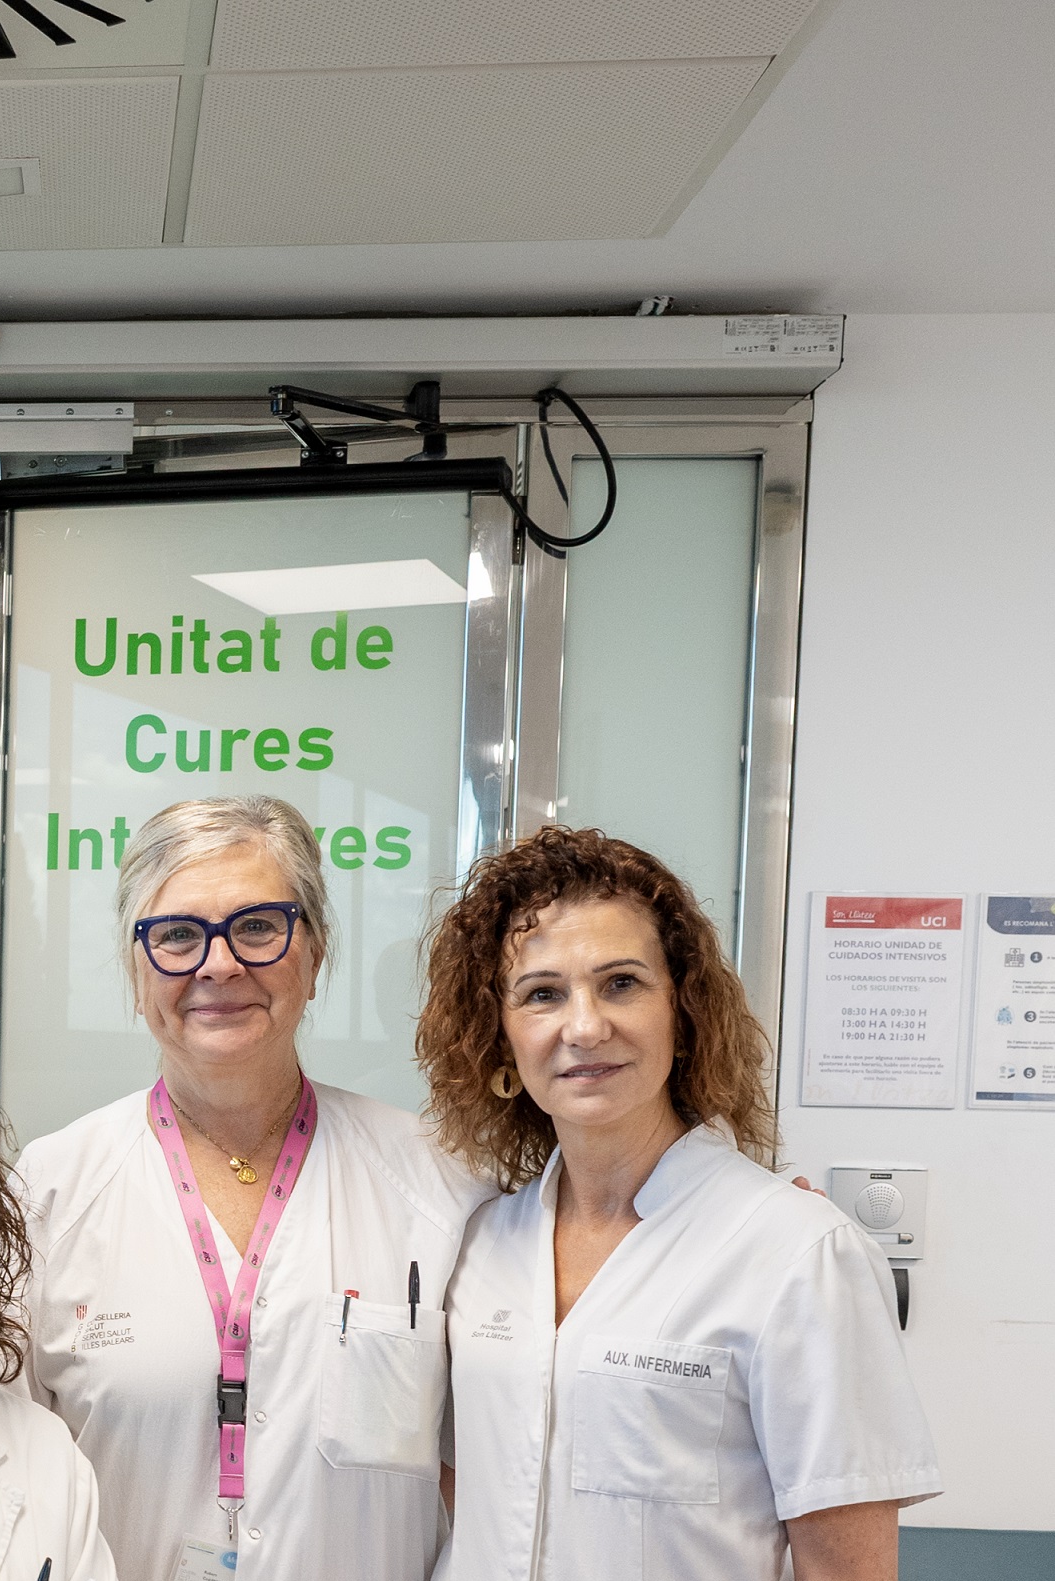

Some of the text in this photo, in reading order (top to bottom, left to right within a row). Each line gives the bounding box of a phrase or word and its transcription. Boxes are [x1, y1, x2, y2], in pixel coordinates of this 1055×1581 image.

[74, 611, 394, 677] Unitat de
[125, 714, 334, 773] Cures
[920, 916, 947, 927] UCI
[834, 941, 943, 950] HORARIO UNIDAD DE
[828, 952, 947, 961] CUIDADOS INTENSIVOS
[843, 975, 887, 983] HORARIOS
[841, 1008, 927, 1017] 08:30 H A 09:30 H
[841, 1020, 926, 1029] 13:00 H A 14:30 H
[841, 1032, 926, 1041] 19:00 H A 21:30 H
[480, 1323, 512, 1332] Hospital
[82, 1327, 131, 1342] SERVEI SALUT
[82, 1336, 135, 1350] ILLES BALEARS
[603, 1350, 712, 1379] AUX. INFERMERIA
